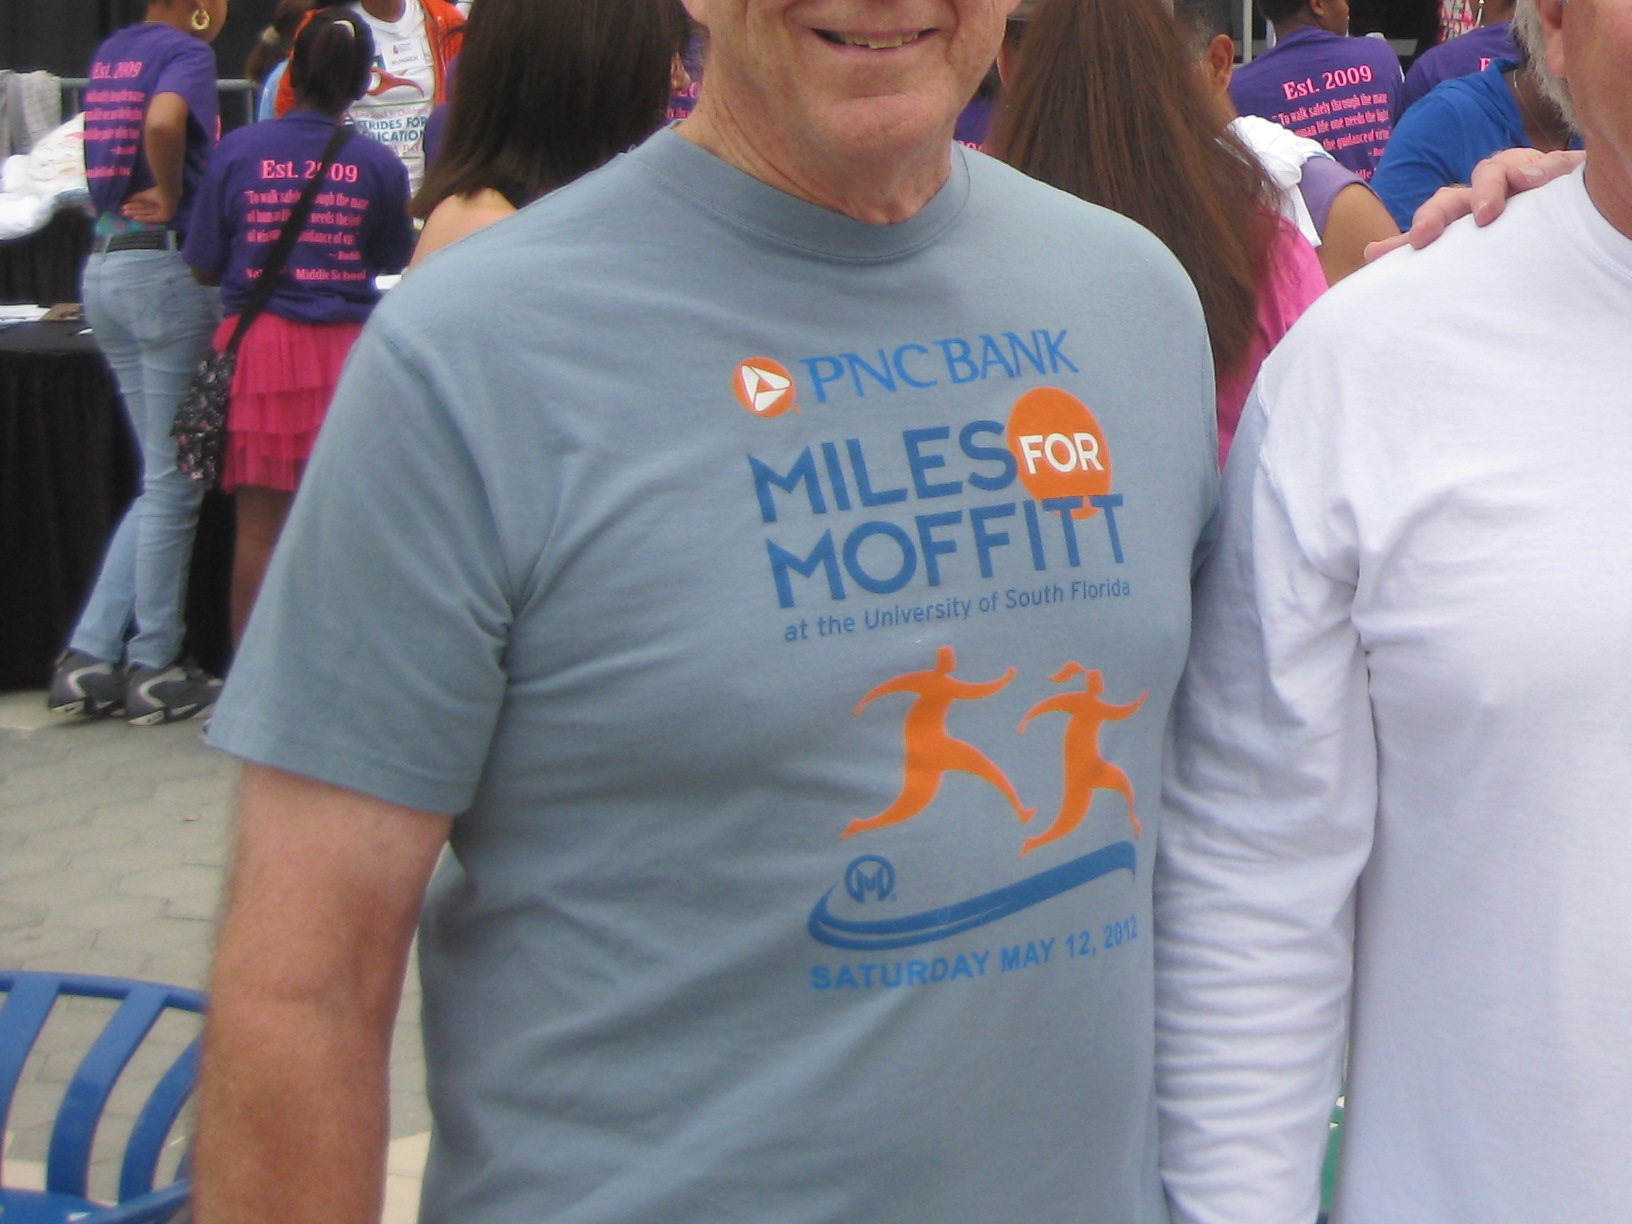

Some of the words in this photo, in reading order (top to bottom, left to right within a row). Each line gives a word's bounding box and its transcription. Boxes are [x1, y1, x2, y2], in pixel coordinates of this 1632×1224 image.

[1283, 78, 1320, 100] Est.
[1322, 65, 1372, 90] 2009
[261, 160, 299, 179] Est.
[798, 342, 938, 404] PNC
[932, 329, 1080, 385] BANK
[747, 419, 1018, 523] MILES
[1018, 432, 1104, 474] FOR
[765, 493, 1124, 608] MOFFITT
[784, 622, 809, 642] at
[817, 614, 856, 635] the
[864, 596, 973, 630] University
[978, 590, 1000, 613] of
[1005, 582, 1064, 609] South
[1070, 578, 1131, 602] Florida
[810, 950, 991, 990] SATURDAY
[1001, 937, 1056, 973] MAY
[1065, 931, 1097, 959] 12,
[1103, 914, 1139, 949] 2012
